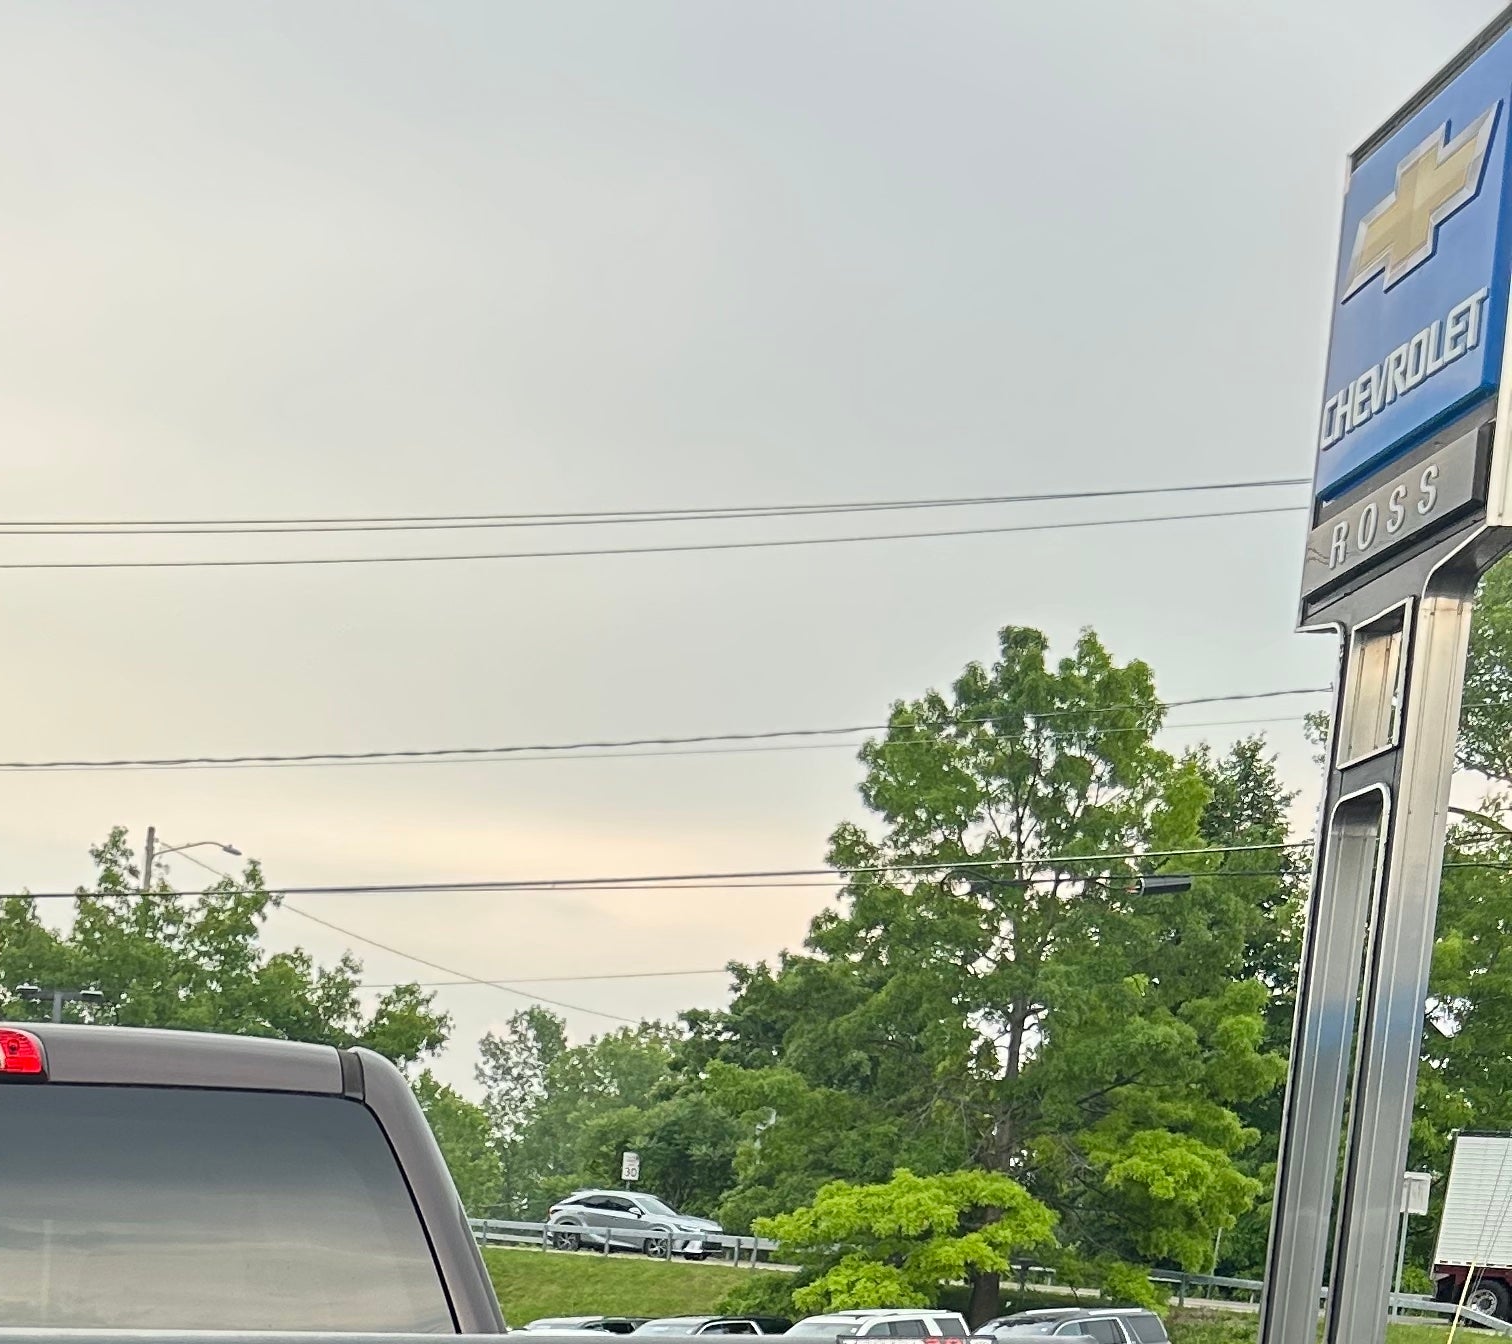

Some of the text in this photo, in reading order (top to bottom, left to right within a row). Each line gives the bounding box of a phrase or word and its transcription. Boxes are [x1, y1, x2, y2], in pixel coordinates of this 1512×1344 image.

[1322, 287, 1489, 450] CHEVROLET
[1328, 464, 1440, 570] ROSS
[624, 1167, 637, 1177] 30
